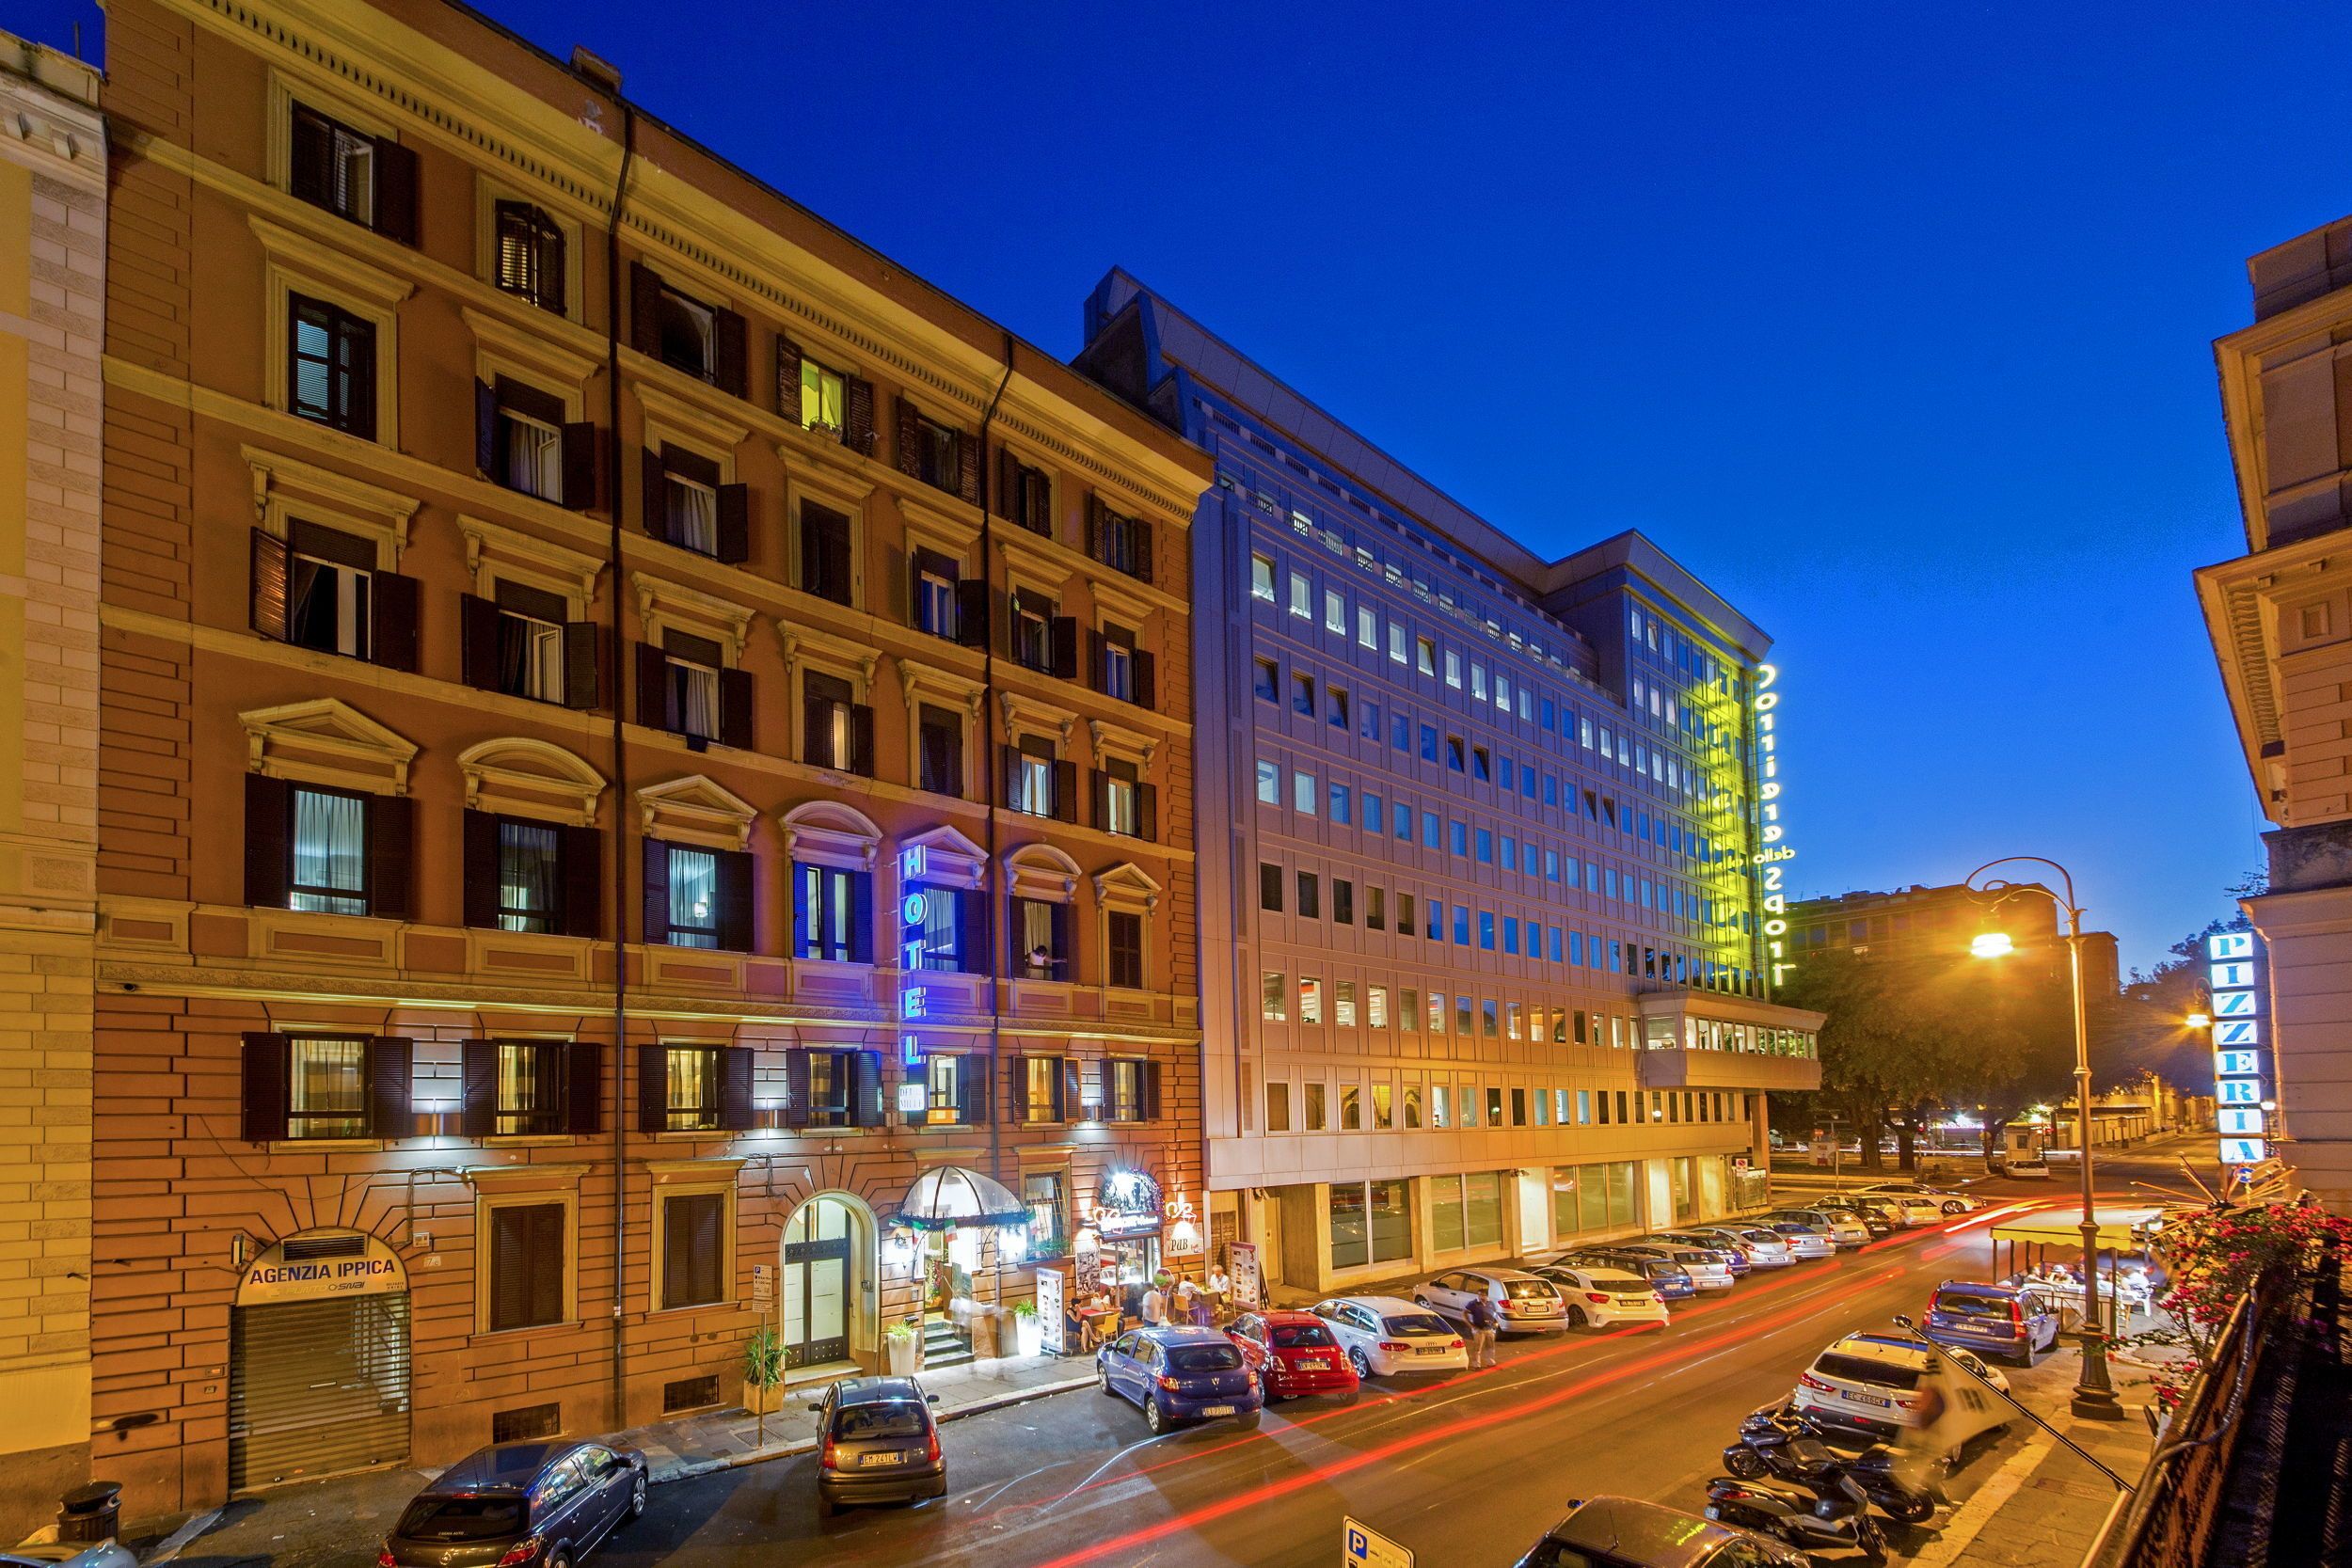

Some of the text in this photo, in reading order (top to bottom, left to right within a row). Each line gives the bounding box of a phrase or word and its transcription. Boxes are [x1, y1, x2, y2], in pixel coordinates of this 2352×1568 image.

[903, 844, 928, 1065] HOTEL
[2217, 937, 2258, 1161] PIZZERIA
[1171, 1238, 1188, 1251] PUB
[249, 1259, 395, 1284] AGENZIA IPPICA
[1353, 1532, 1364, 1552] P
